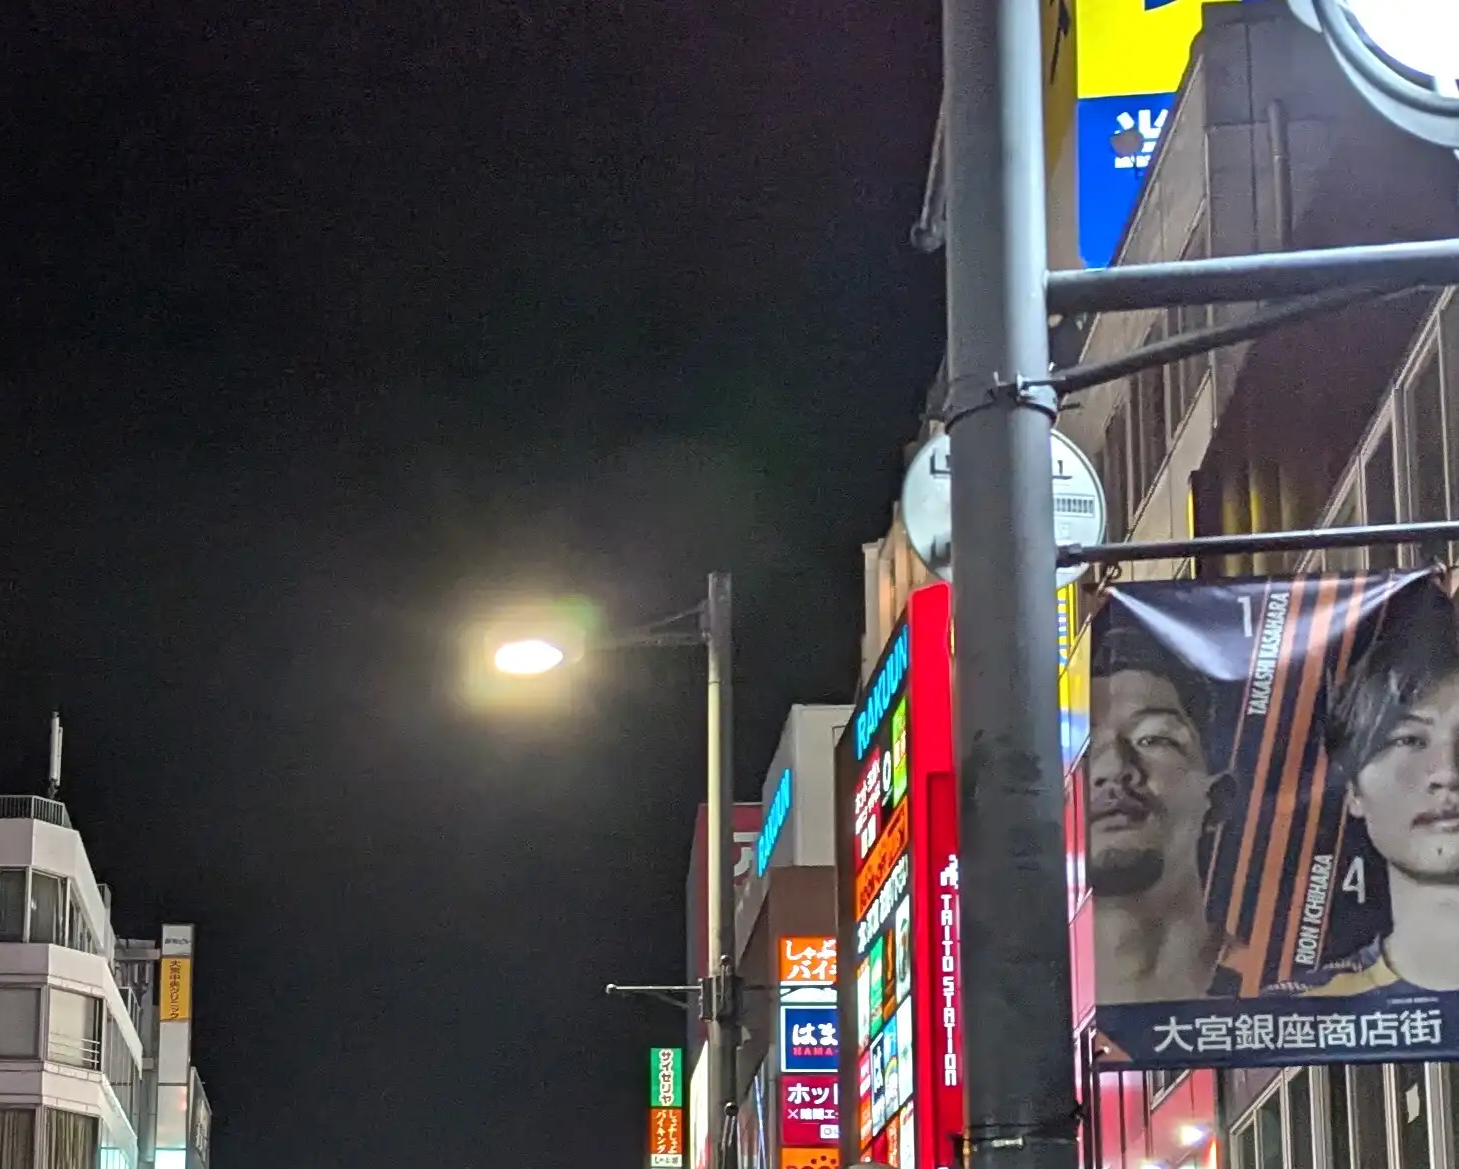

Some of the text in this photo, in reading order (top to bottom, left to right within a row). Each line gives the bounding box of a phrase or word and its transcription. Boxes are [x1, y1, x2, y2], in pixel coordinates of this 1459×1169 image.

[855, 624, 909, 761] RAKUUN
[1342, 856, 1366, 904] 4
[941, 894, 957, 1087] TAITO STATION
[1153, 1010, 1442, 1055] 大宮銀座商店街
